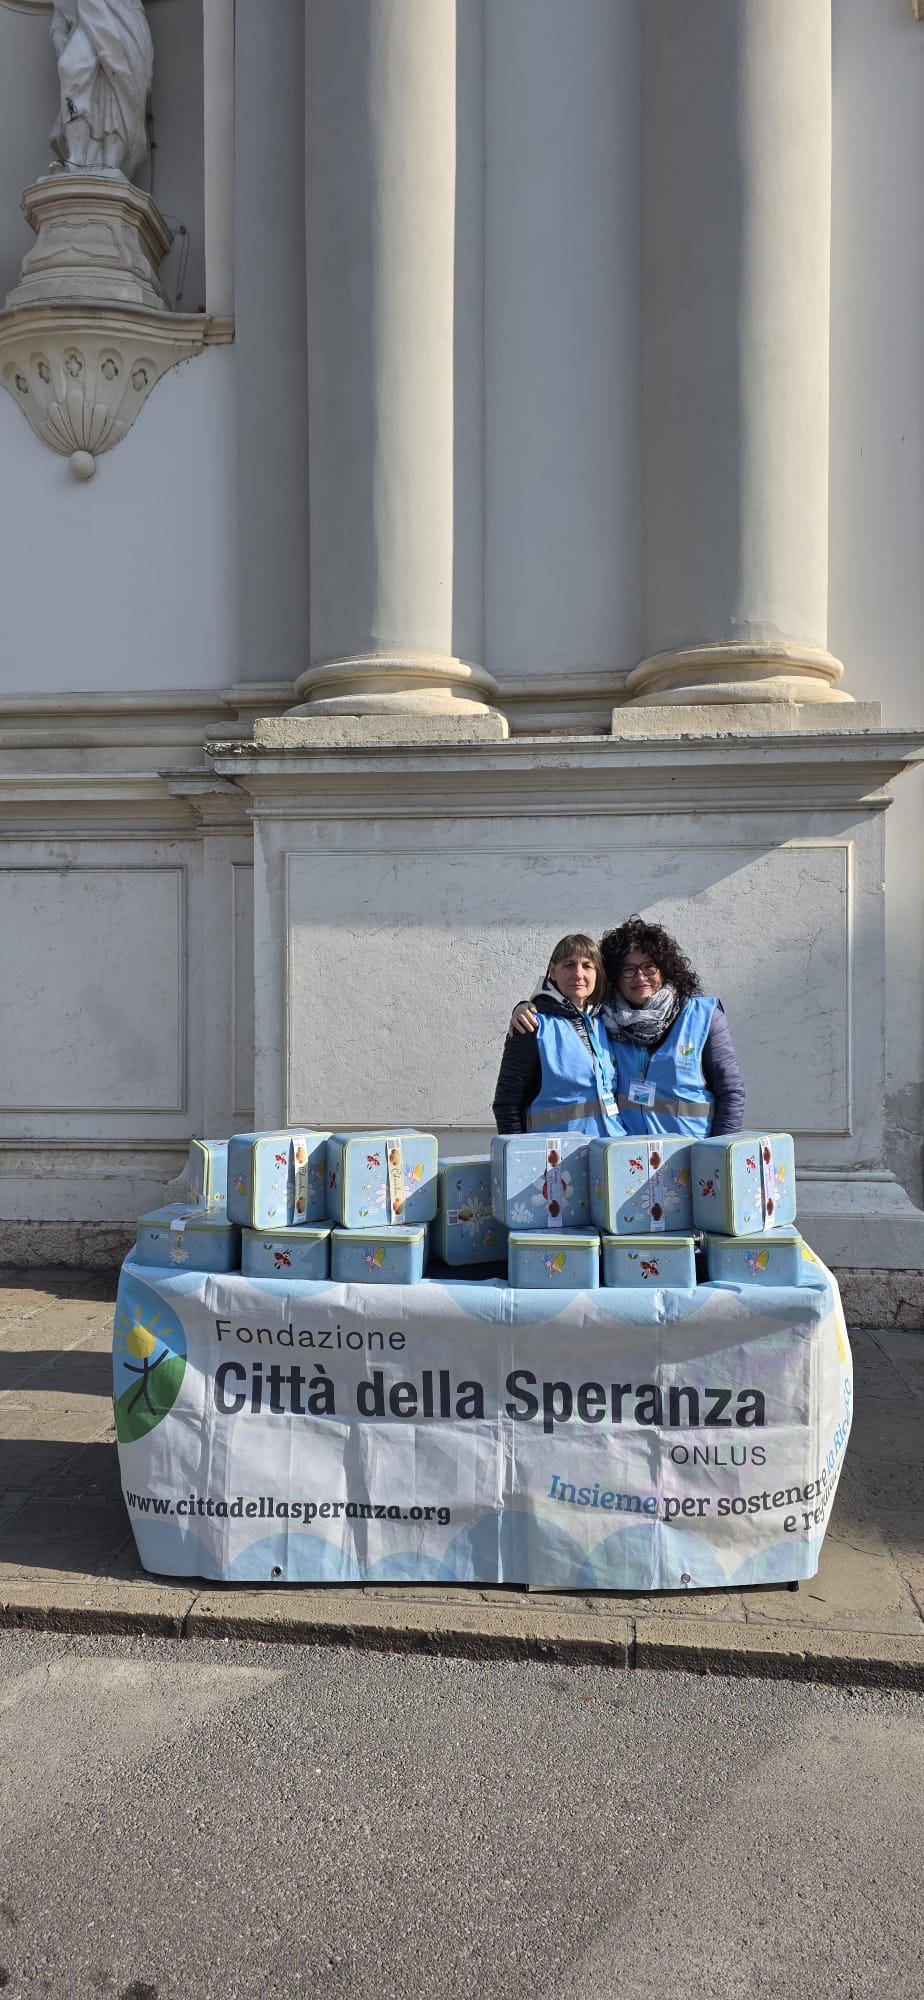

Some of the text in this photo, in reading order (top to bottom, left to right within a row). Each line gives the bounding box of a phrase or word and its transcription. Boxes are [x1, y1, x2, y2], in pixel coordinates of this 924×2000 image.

[215, 1319, 407, 1351] Fondazione
[214, 1361, 766, 1433] Città della Speranza
[671, 1445, 767, 1466] ONLUS
[126, 1489, 451, 1525] www.cittadellasperanza.org
[547, 1475, 657, 1514] Insieme
[662, 1492, 711, 1521] per
[717, 1468, 828, 1518] sostenere
[783, 1514, 797, 1533] e
